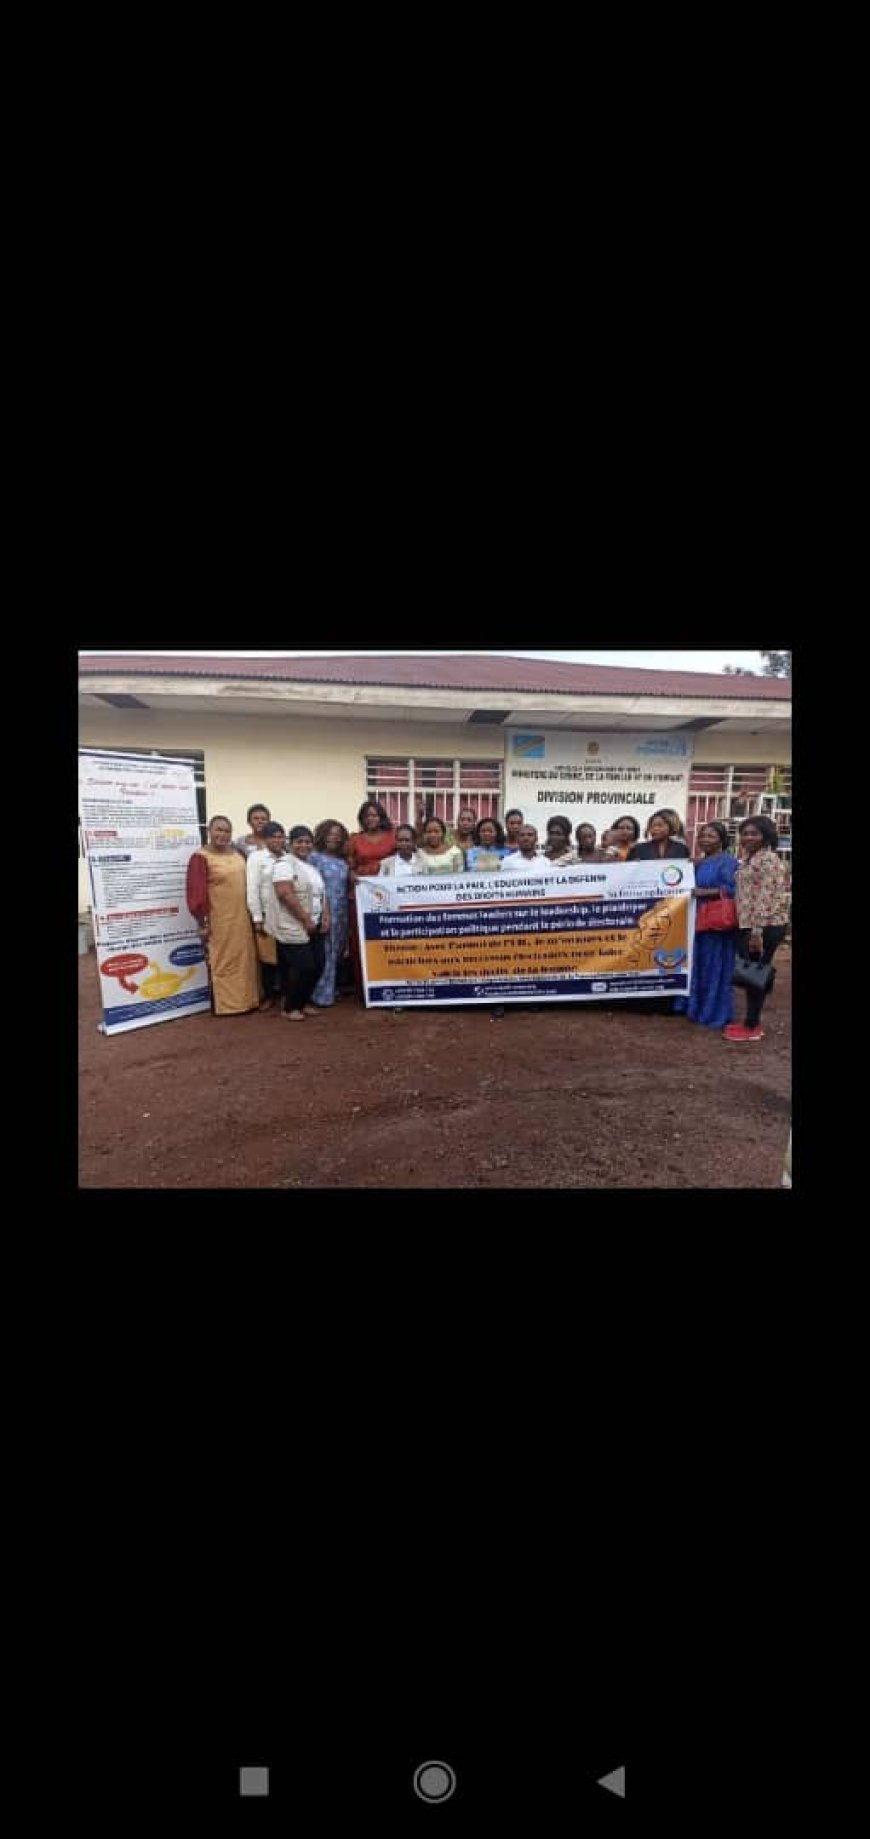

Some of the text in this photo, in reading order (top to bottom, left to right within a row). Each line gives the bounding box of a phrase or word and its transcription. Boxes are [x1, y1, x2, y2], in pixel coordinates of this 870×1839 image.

[537, 791, 657, 804] DIVISION PROVINCIALE
[396, 884, 428, 893] ACTION
[429, 882, 452, 892] POUR
[454, 882, 464, 890] LA
[545, 876, 554, 886] ET
[556, 876, 567, 885] LA
[456, 892, 472, 901] DES
[475, 891, 504, 900] DROITS
[380, 914, 425, 924] Formation
[426, 912, 441, 922] des
[514, 908, 529, 918] sur
[530, 906, 539, 916] le
[592, 904, 600, 913] le
[380, 929, 388, 937] et
[391, 928, 400, 936] la
[400, 926, 458, 938] participation
[459, 924, 499, 936] politique
[502, 922, 539, 934] pendant
[541, 920, 550, 929] la
